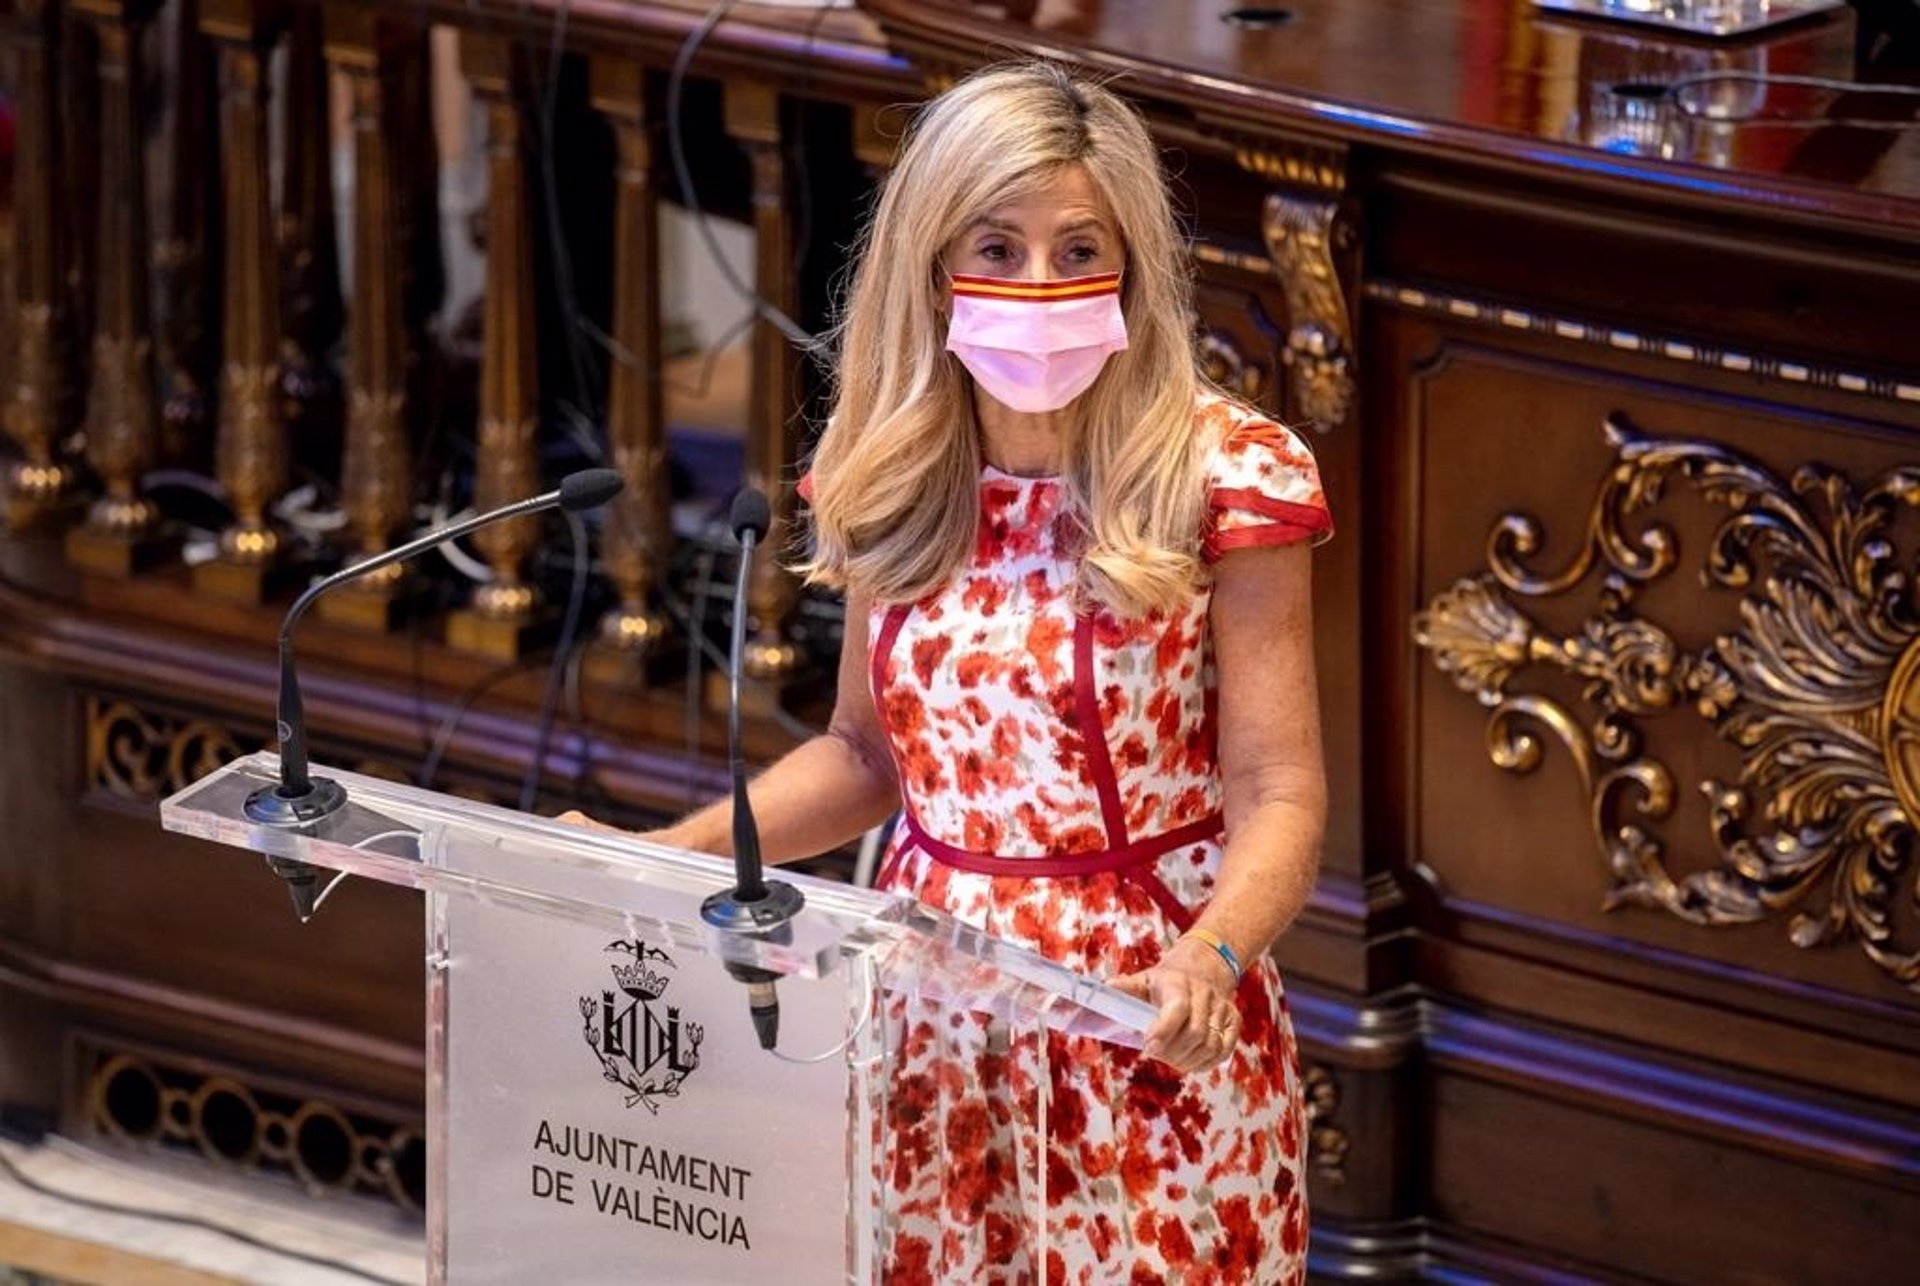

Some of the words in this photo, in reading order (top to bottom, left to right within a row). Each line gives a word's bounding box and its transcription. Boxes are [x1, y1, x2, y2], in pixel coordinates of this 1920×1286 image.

[533, 1120, 751, 1200] AJUNTAMENT
[532, 1165, 574, 1204] DE
[592, 1179, 750, 1250] VALÈNCIA
